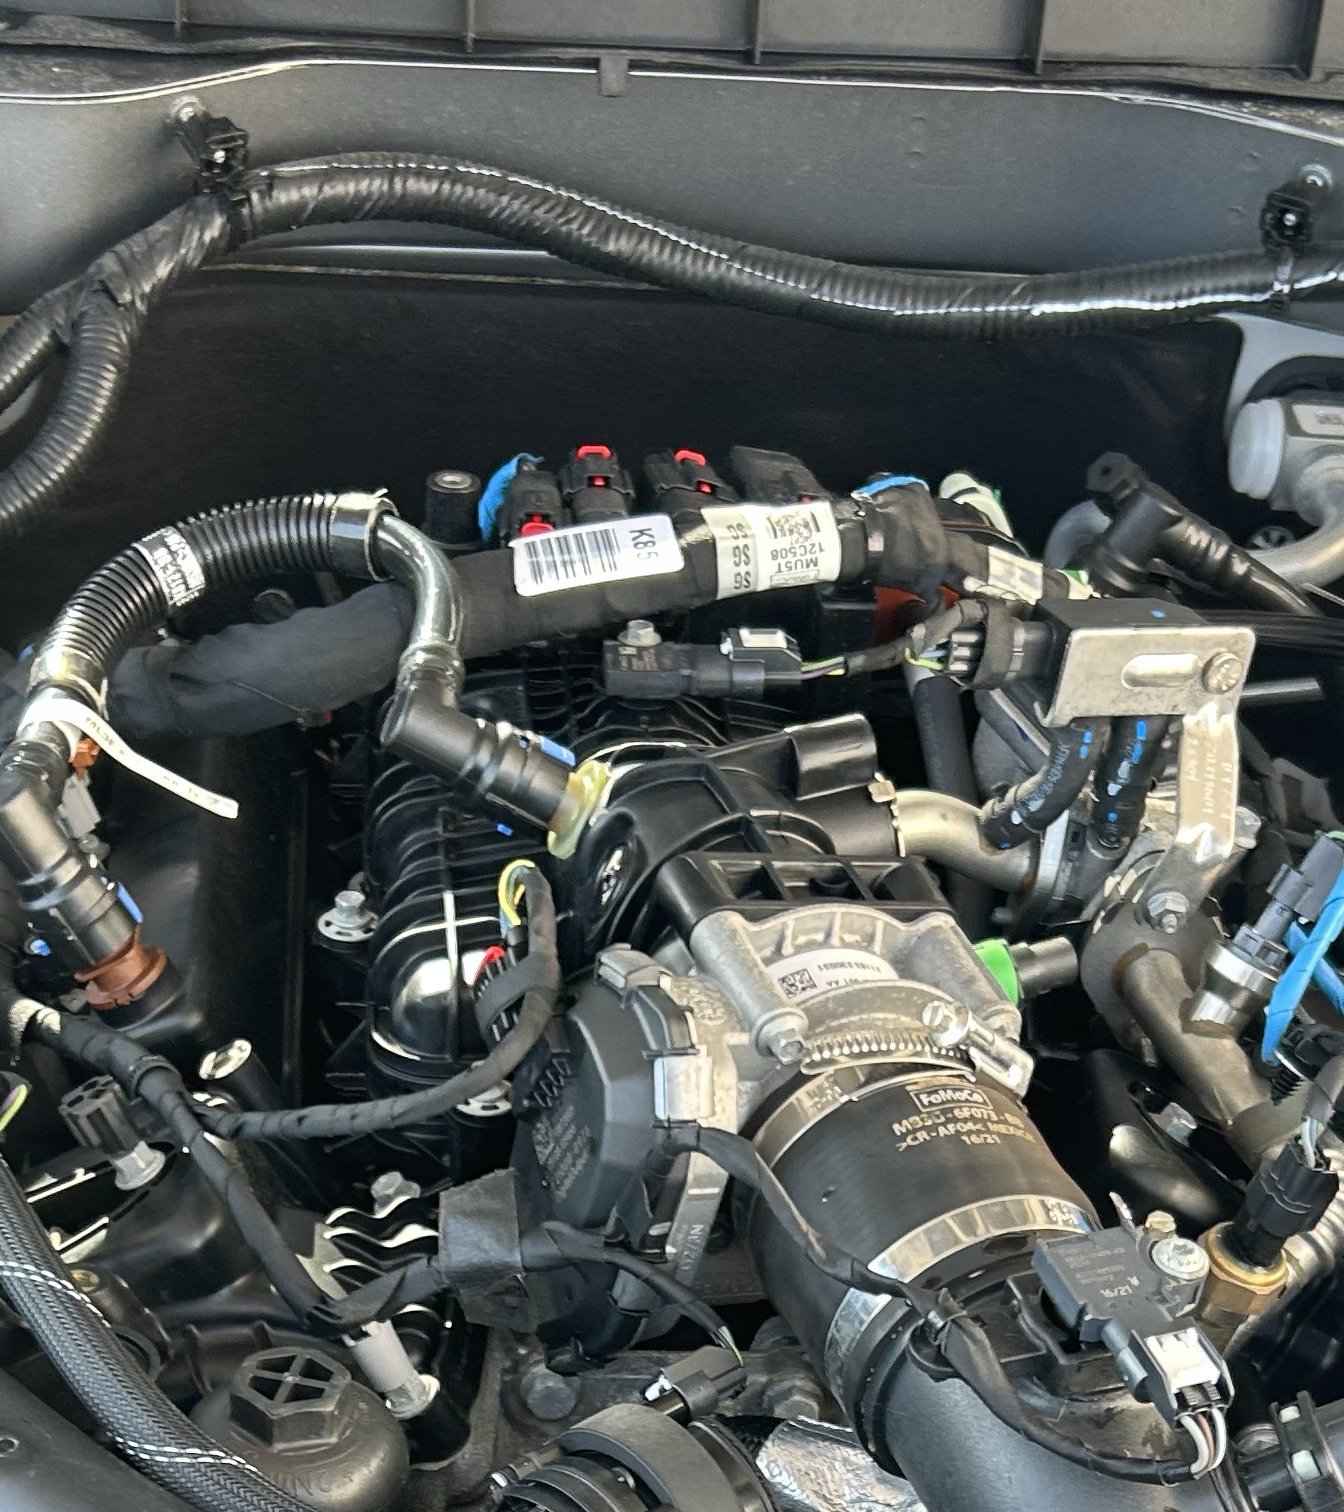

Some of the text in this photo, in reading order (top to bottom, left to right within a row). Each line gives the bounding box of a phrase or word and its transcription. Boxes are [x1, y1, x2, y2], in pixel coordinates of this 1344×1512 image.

[629, 527, 659, 561] K85
[770, 543, 826, 562] 12C508
[733, 545, 751, 567] SG
[734, 571, 752, 590] SG
[919, 1088, 985, 1106] FoMoCo
